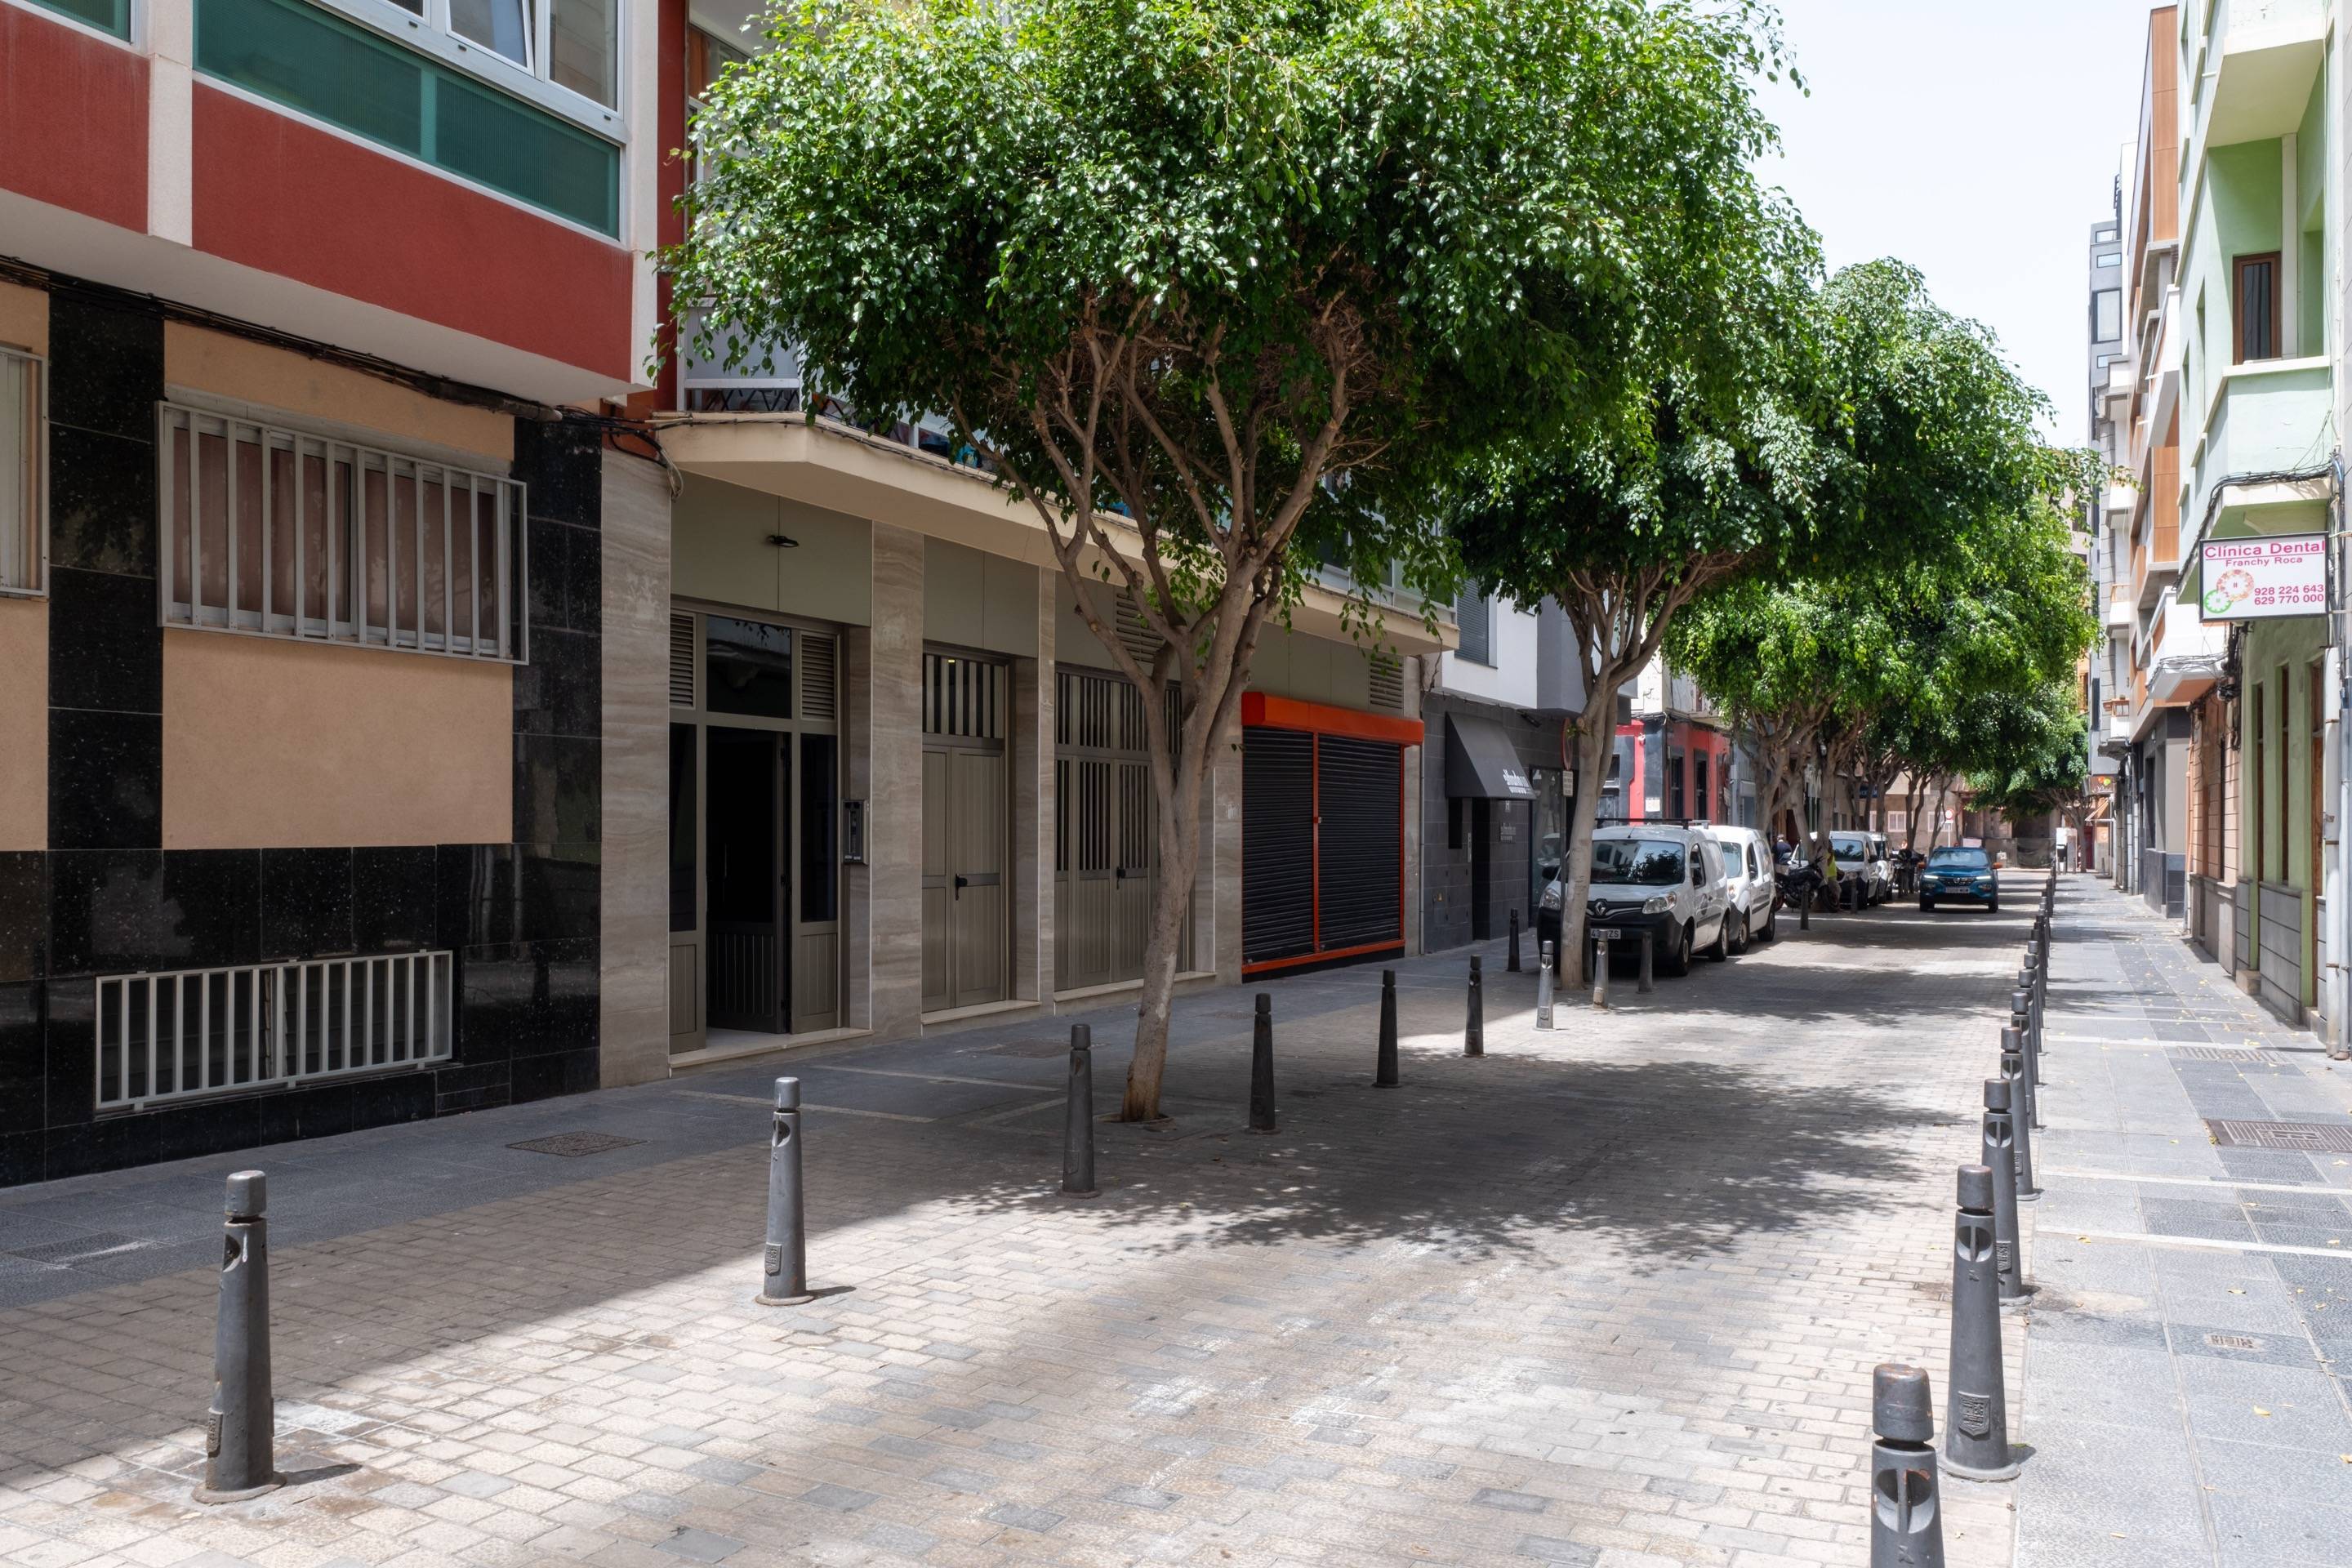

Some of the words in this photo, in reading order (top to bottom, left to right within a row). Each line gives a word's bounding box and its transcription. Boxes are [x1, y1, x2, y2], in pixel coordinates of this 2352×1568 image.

[2205, 545, 2262, 558] Clínica
[2270, 541, 2326, 555] Dental
[2225, 557, 2270, 567] Franchy
[2274, 556, 2303, 564] Roca
[2254, 586, 2275, 596] 928
[2278, 586, 2299, 595] 224
[2303, 585, 2324, 593] 643
[2254, 596, 2275, 605] 629
[2279, 595, 2300, 604] 770
[2303, 594, 2324, 603] 000
